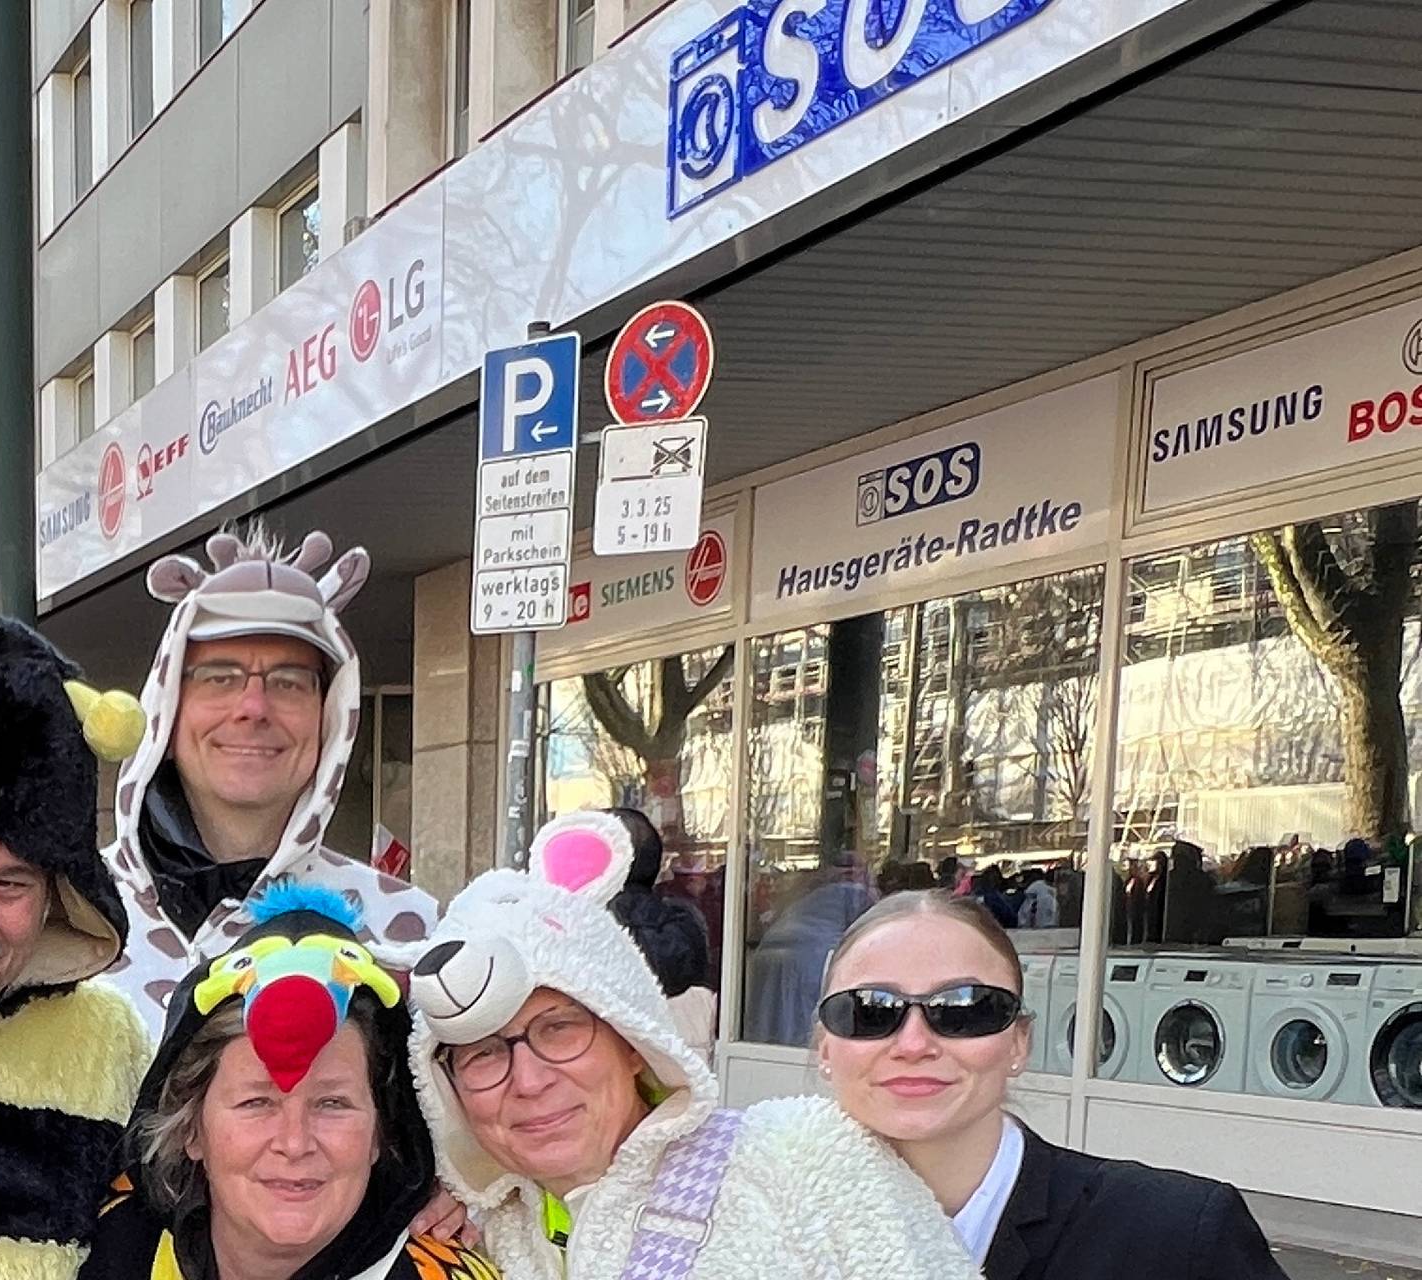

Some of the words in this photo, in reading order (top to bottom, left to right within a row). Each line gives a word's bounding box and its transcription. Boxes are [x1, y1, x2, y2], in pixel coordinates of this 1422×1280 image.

[751, 0, 1011, 144] SO
[388, 259, 425, 333] LG
[284, 322, 336, 405] AEG
[200, 376, 273, 452] Bauknecht
[503, 357, 554, 452] P
[1153, 384, 1324, 463] SAMSUNG
[485, 487, 566, 512] Seitenstreifen
[501, 468, 520, 488] auf
[525, 466, 550, 486] dem
[885, 447, 975, 514] SOS
[40, 491, 91, 548] SAMSUNG
[511, 524, 534, 542] mit
[618, 526, 626, 545] 5
[644, 522, 658, 544] 19
[483, 544, 562, 565] Parkschein
[777, 499, 1082, 600] Hausgeräte-Radtke
[481, 575, 561, 597] werktags
[484, 604, 493, 622] 9
[517, 601, 536, 621] 20
[545, 599, 554, 618] h
[601, 565, 675, 607] SIEMENS
